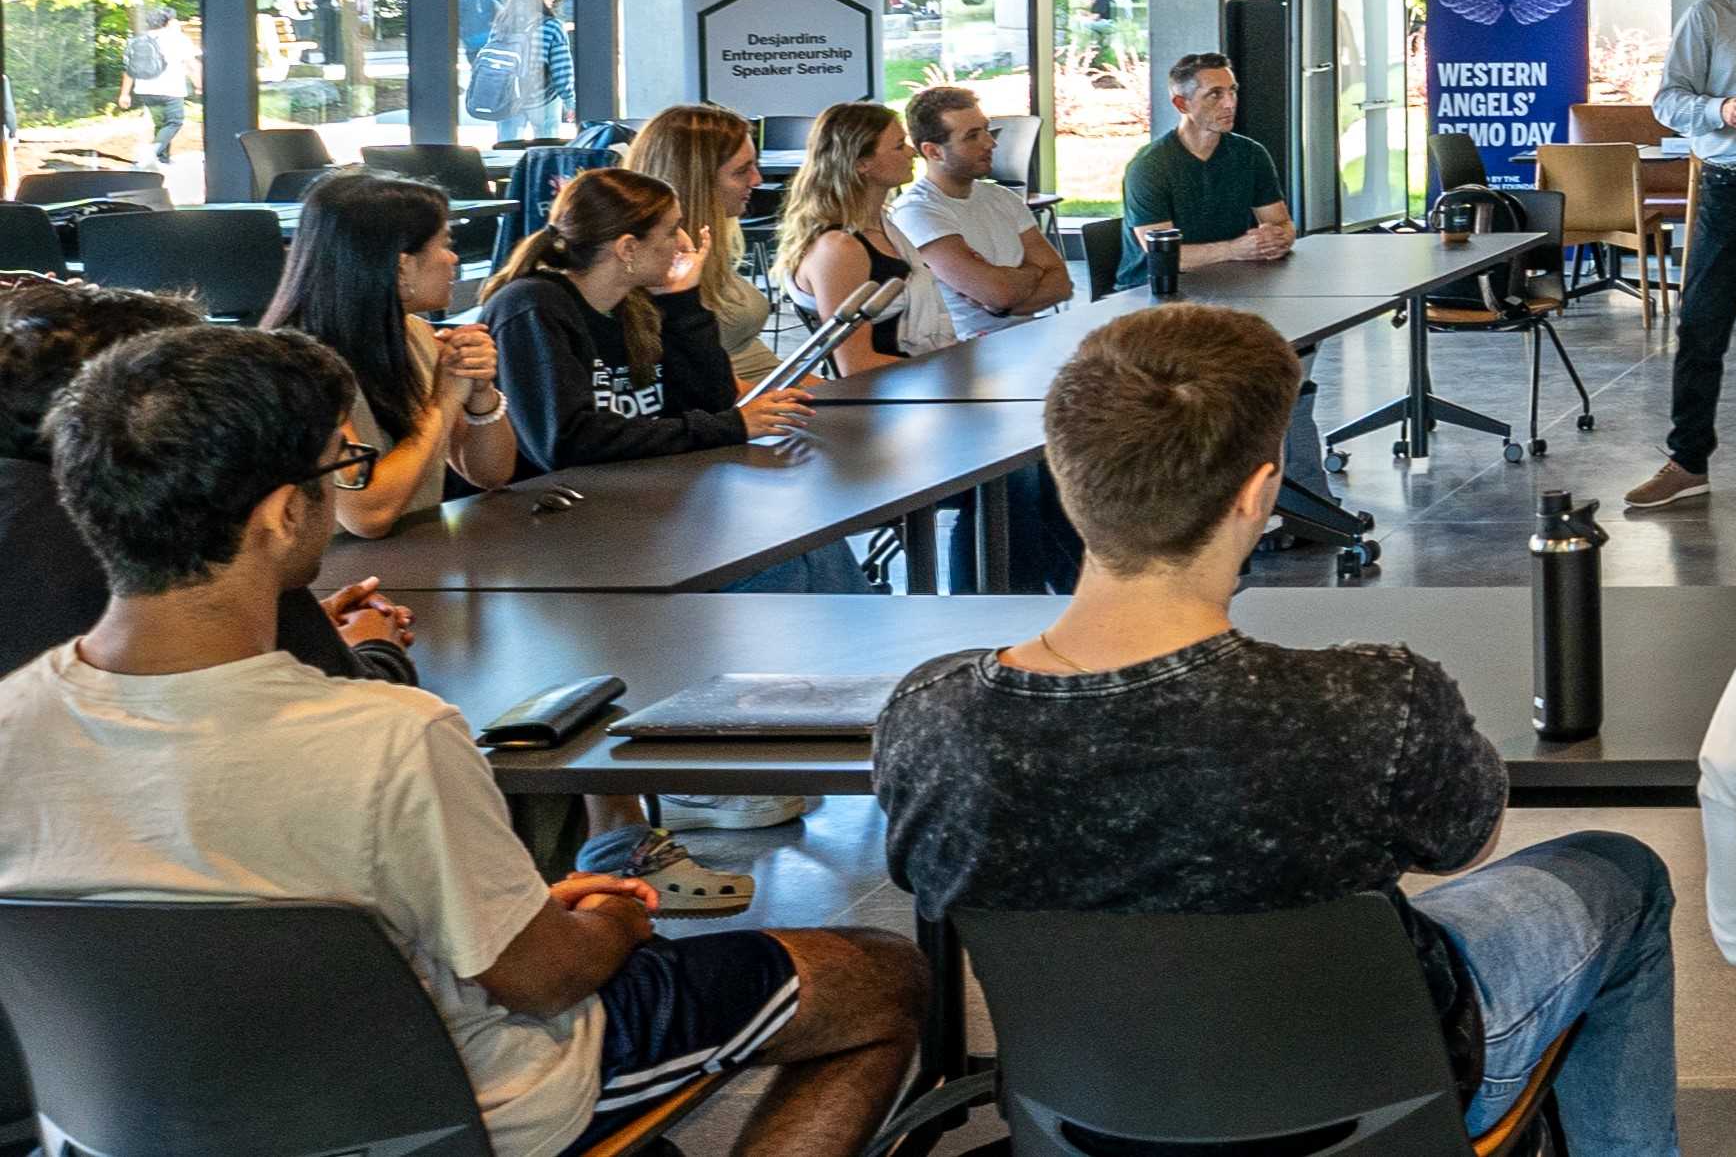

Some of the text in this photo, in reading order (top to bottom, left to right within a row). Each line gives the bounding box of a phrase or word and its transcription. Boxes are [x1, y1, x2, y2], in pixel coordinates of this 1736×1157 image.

[747, 33, 827, 47] Desjardins
[722, 47, 853, 63] Entrepreneurship
[732, 63, 844, 78] Speaker Series
[1437, 62, 1547, 87] WESTERN
[1511, 122, 1556, 147] DAY
